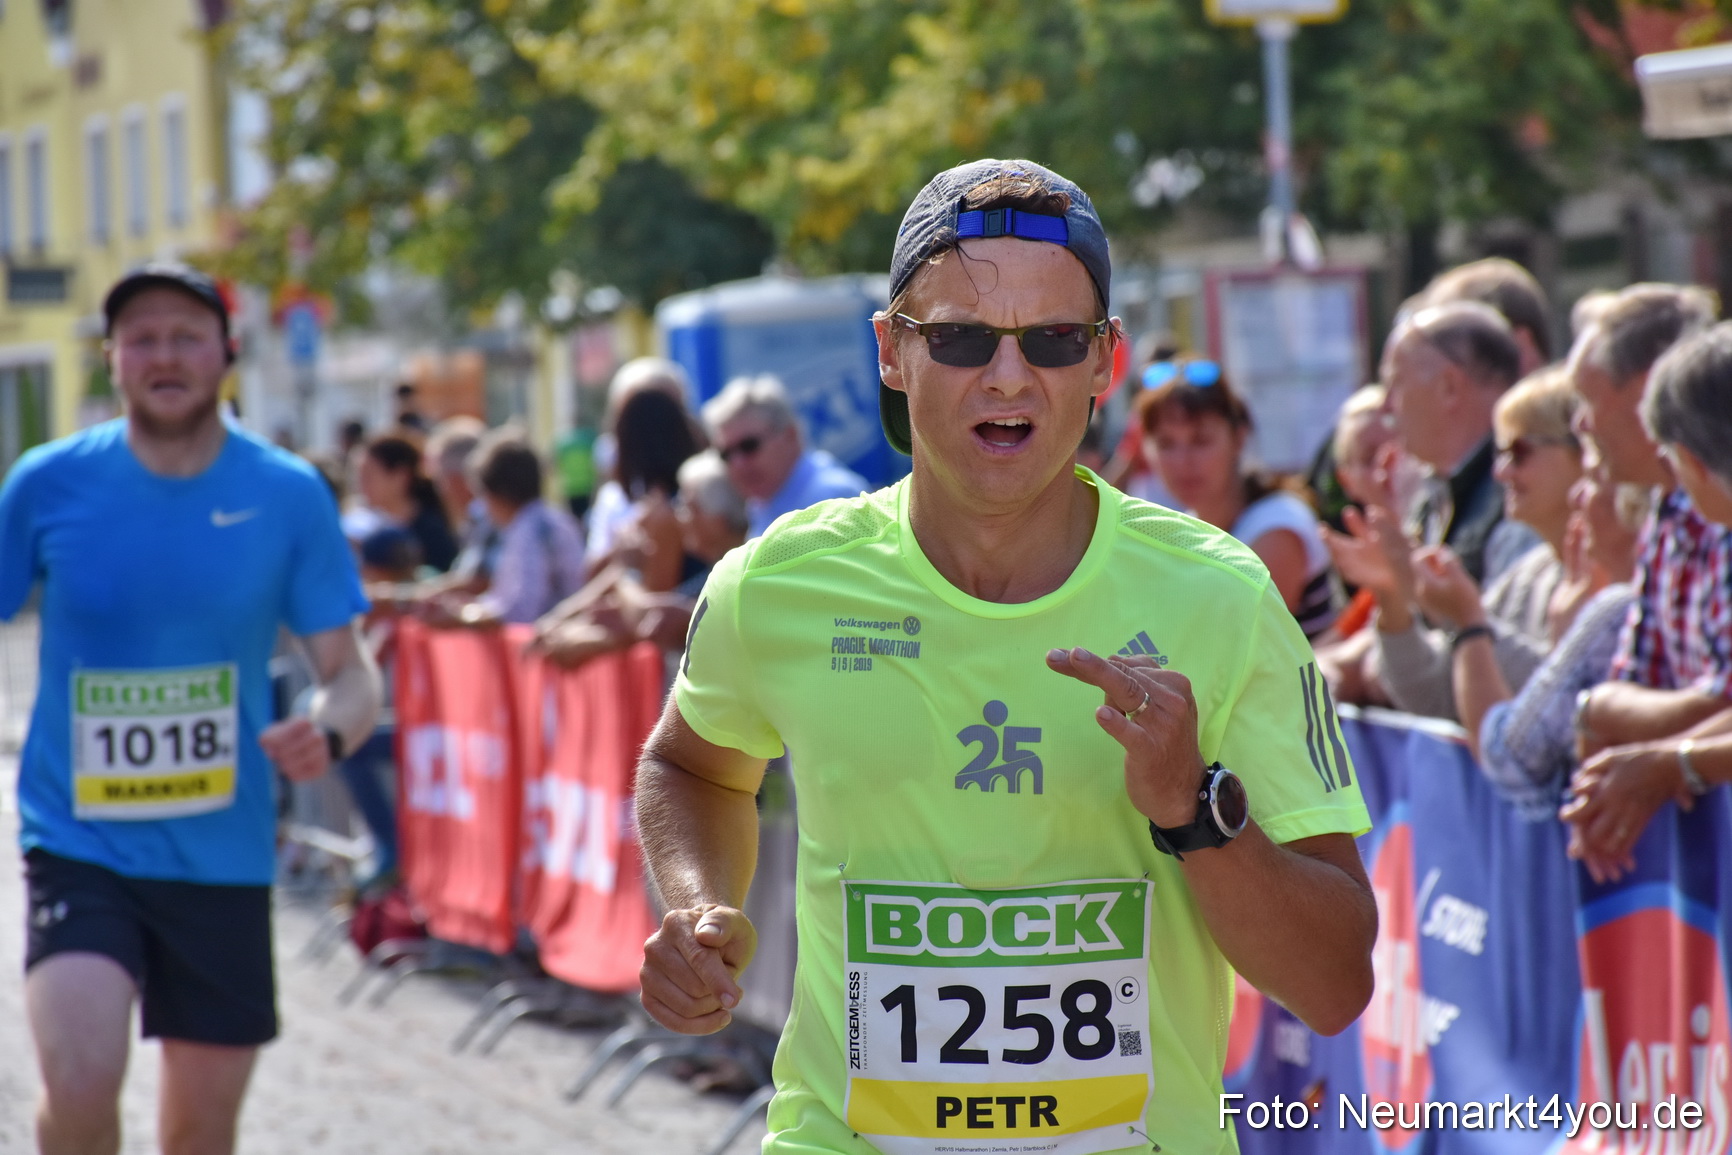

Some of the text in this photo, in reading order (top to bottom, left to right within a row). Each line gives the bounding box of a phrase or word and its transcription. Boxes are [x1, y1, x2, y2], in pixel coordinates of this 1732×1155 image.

[834, 618, 900, 631] Volkswagen
[832, 637, 920, 659] PRAGUE MARATHON
[89, 676, 216, 706] BOCK
[95, 720, 217, 768] 1018
[955, 724, 1043, 782] 25
[867, 894, 1118, 956] BOCK
[1121, 982, 1134, 997] C
[880, 979, 1116, 1065] 1258
[936, 1095, 1059, 1129] PETR
